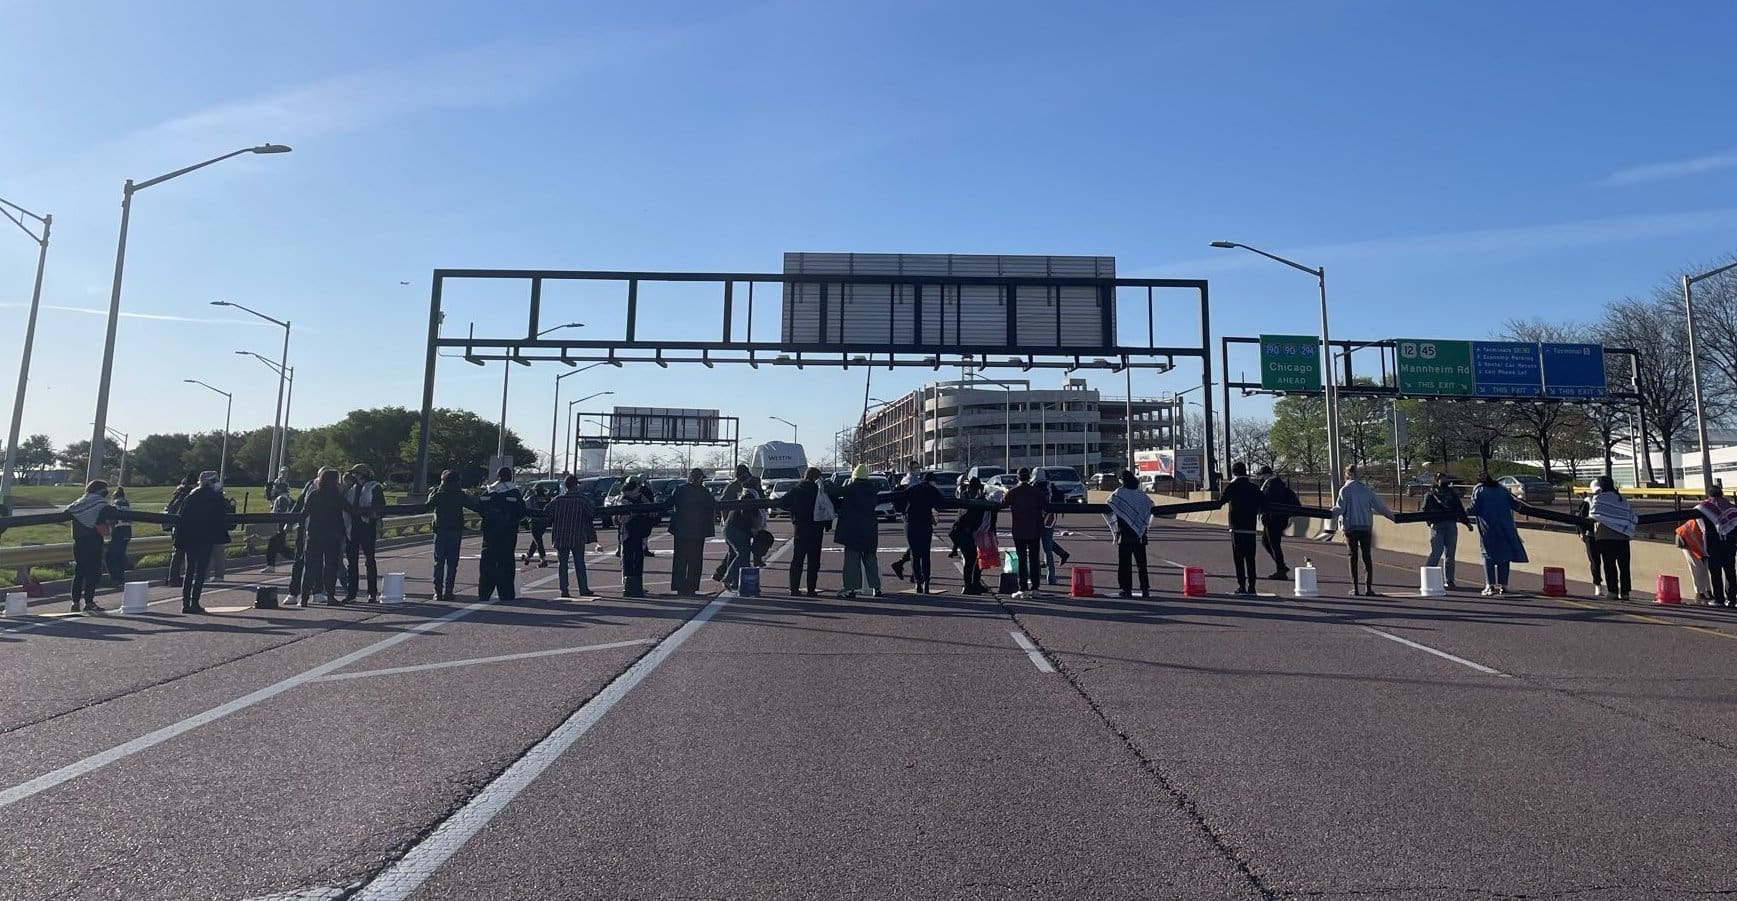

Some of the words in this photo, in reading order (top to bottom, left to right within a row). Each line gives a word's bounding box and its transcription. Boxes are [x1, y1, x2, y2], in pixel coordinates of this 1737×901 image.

[1404, 345, 1415, 355] 12
[1422, 346, 1435, 356] 45
[1269, 362, 1312, 373] Chicago
[1400, 363, 1454, 374] Mannheim
[1457, 365, 1470, 375] Rd
[1417, 381, 1435, 389] THIS
[1439, 381, 1455, 389] EXIT
[1578, 388, 1593, 396] EXIT
